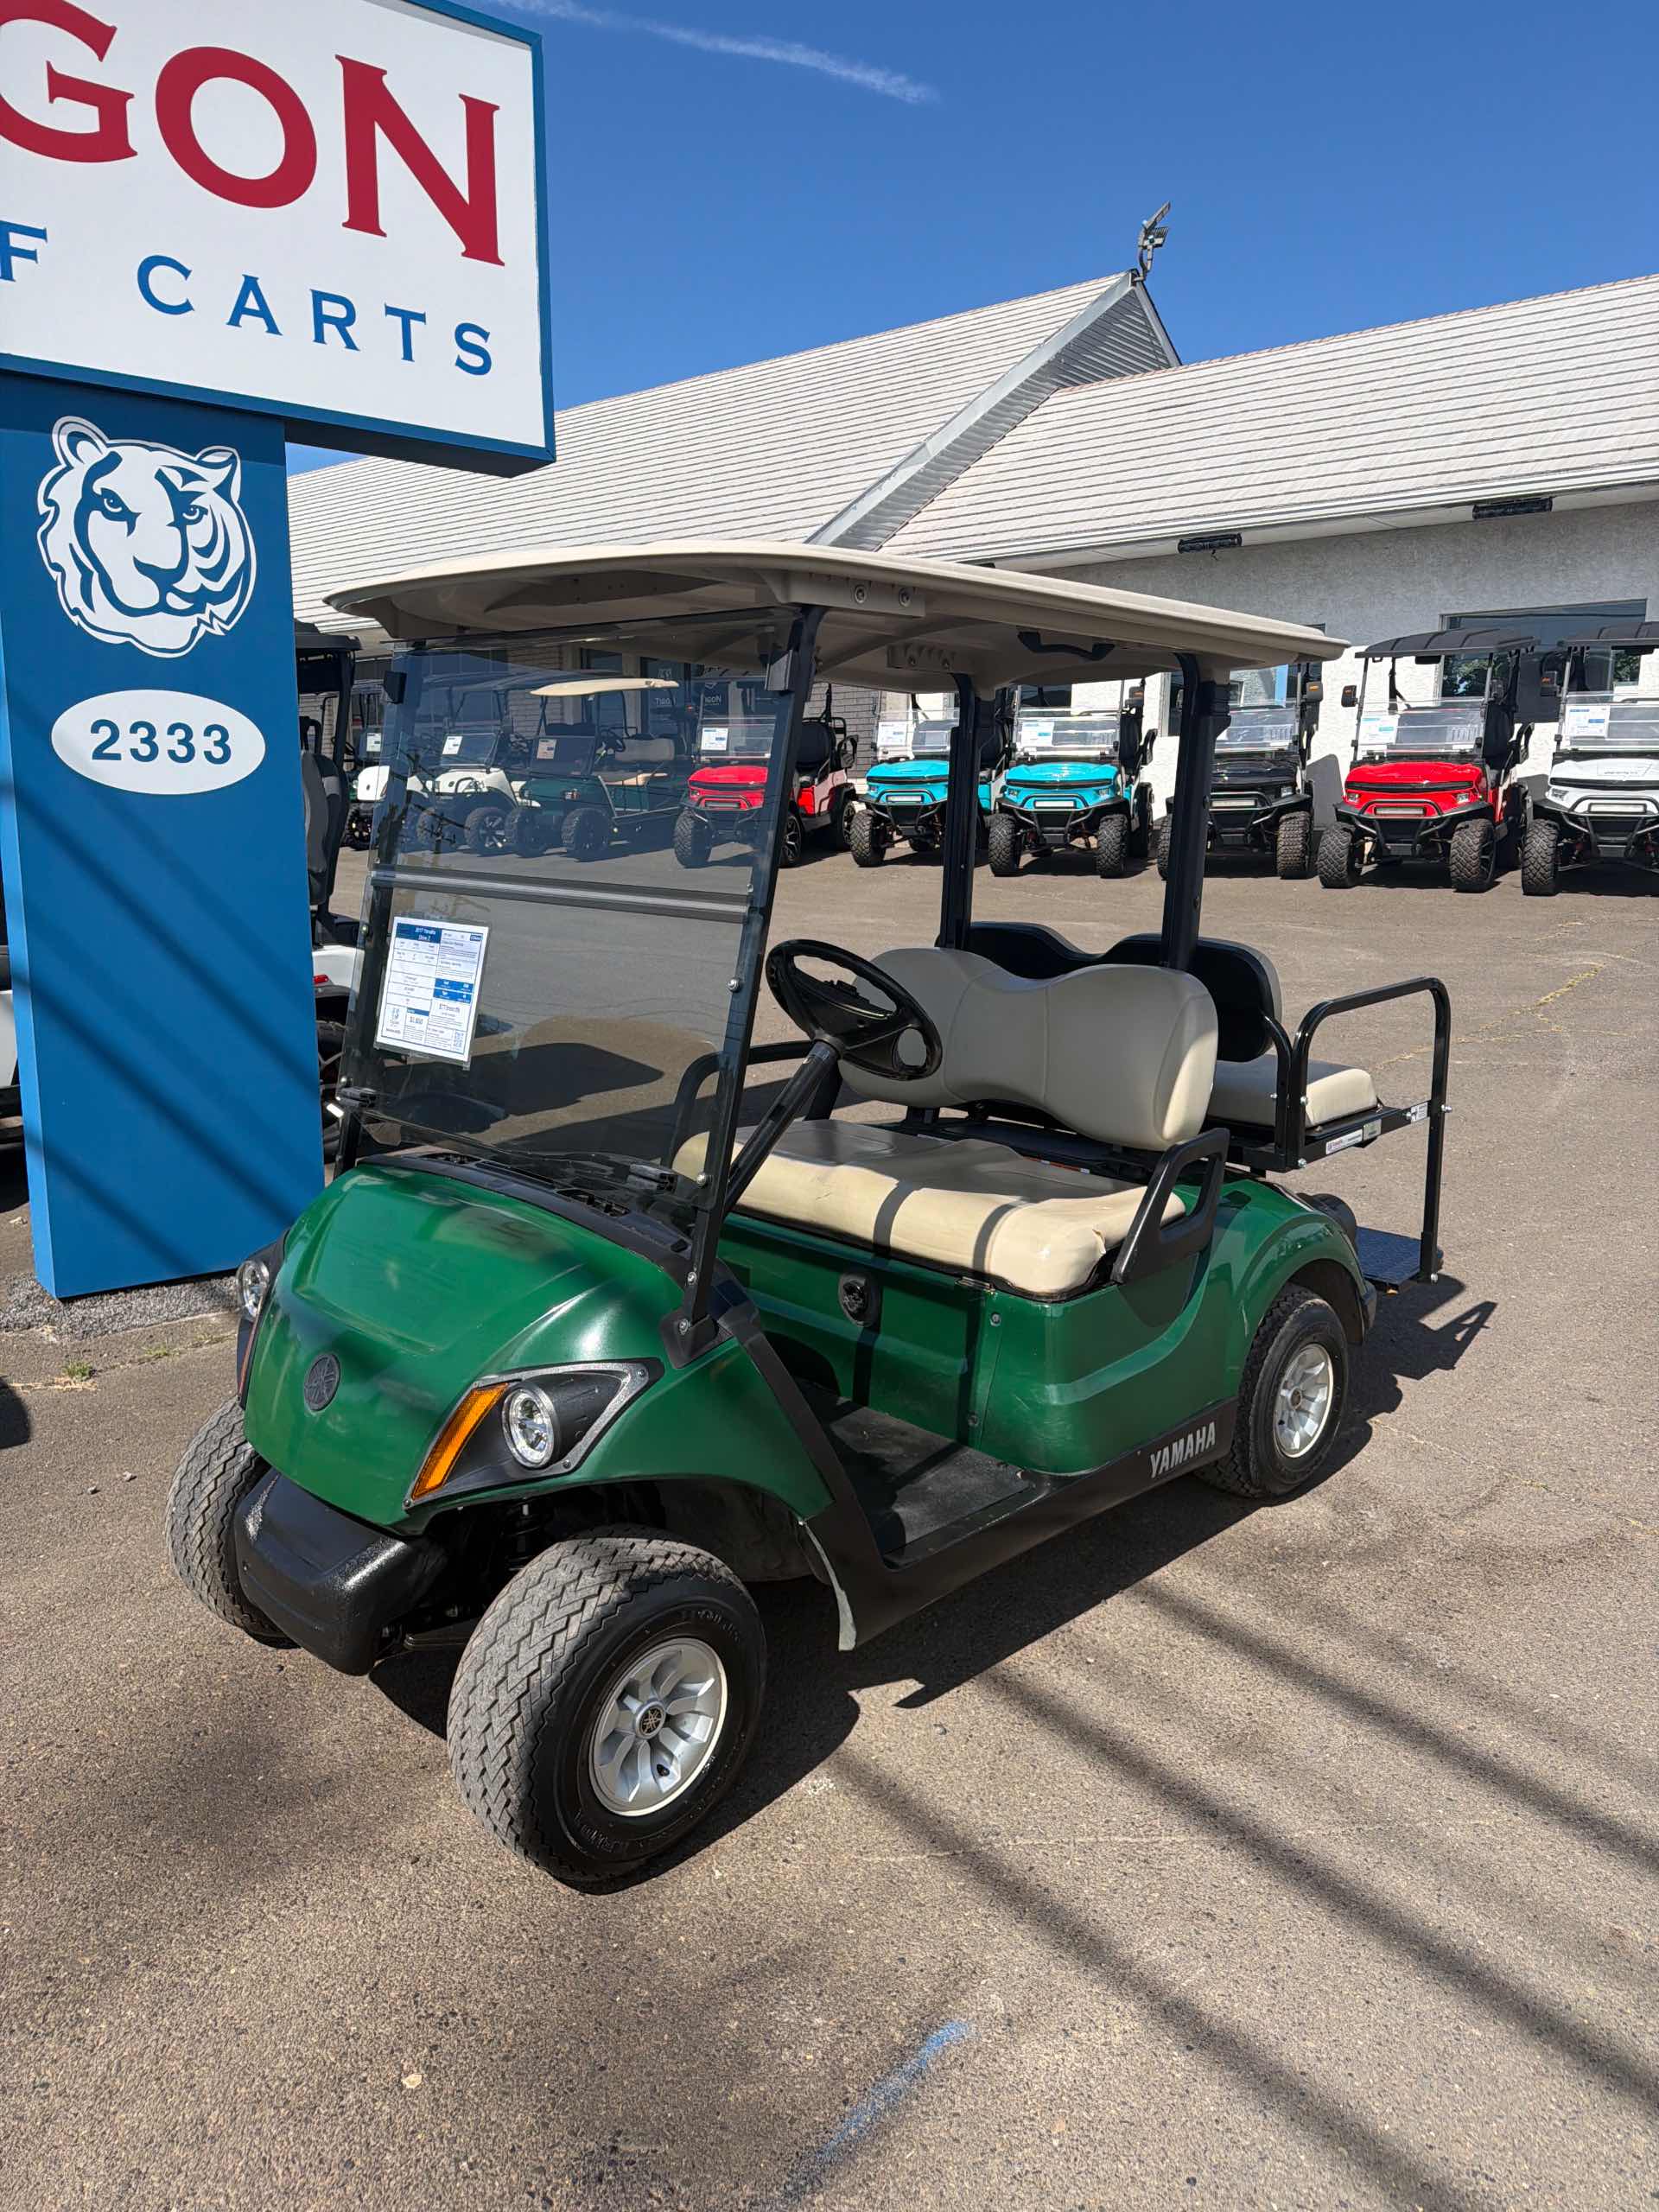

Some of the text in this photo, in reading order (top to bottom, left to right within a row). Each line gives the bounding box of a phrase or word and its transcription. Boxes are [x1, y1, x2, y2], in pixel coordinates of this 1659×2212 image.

[0, 0, 505, 266] GON
[0, 219, 493, 377] F CARTS
[90, 718, 232, 766] 2333
[1150, 1421, 1216, 1478] YAMAHA
